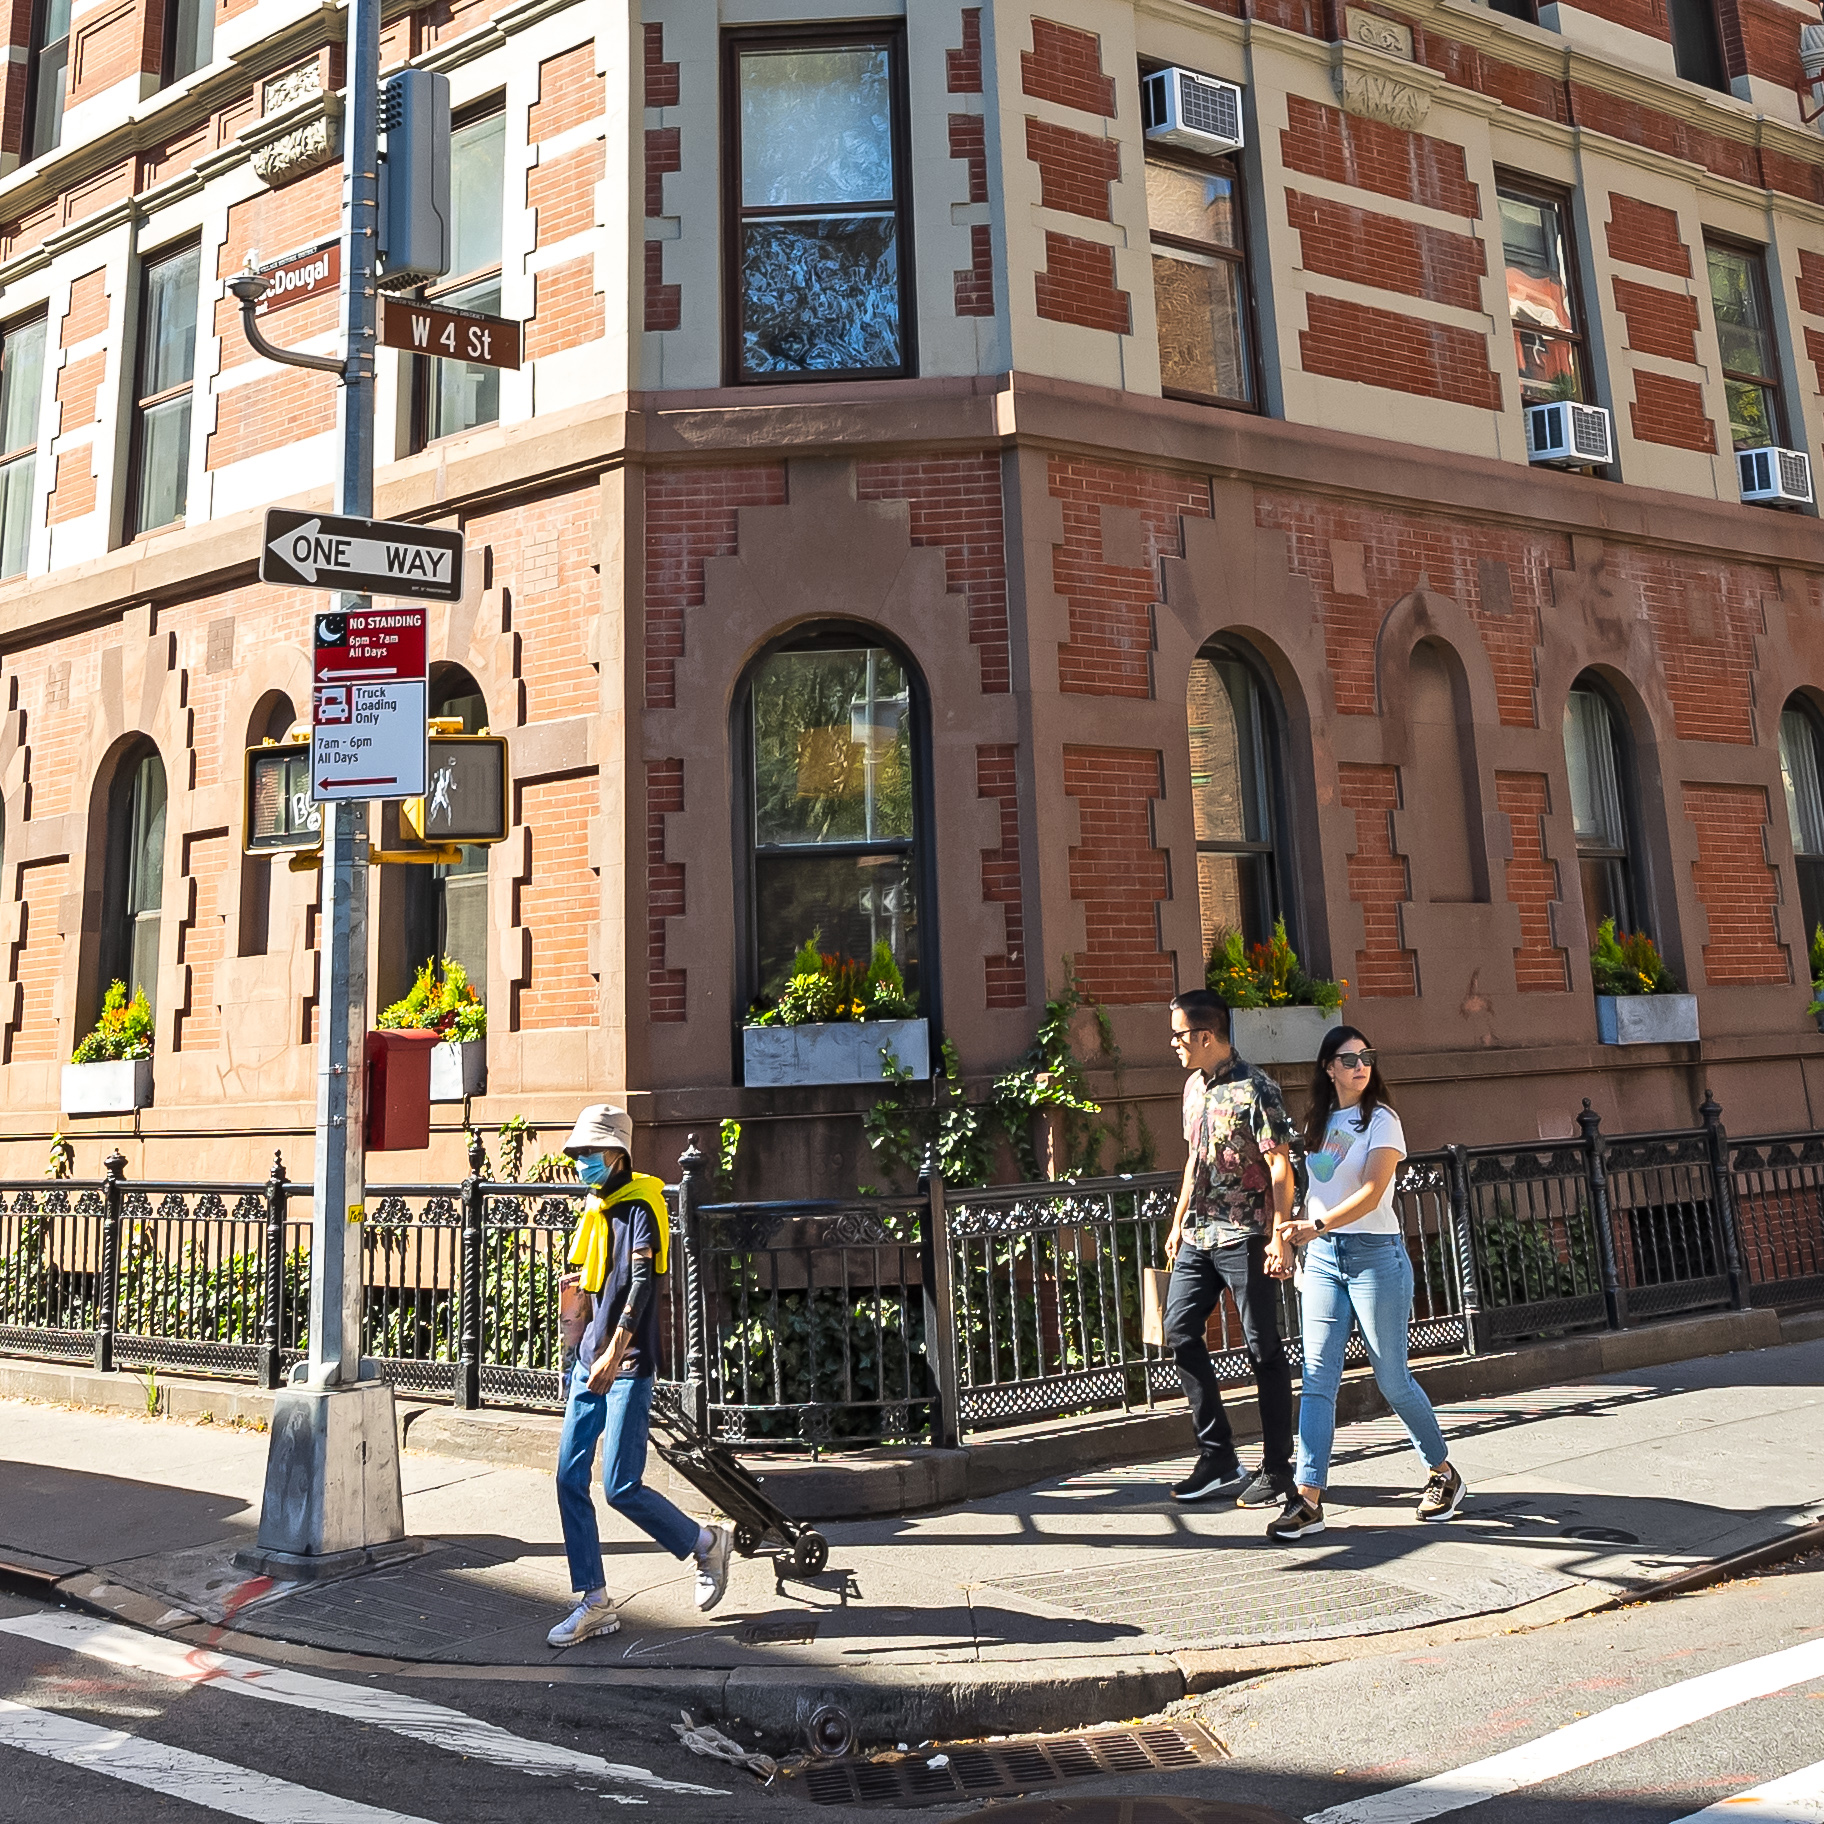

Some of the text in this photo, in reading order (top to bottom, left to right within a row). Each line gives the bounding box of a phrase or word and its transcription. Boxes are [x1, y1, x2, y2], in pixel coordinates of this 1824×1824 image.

[408, 299, 432, 310] VILLAGE
[432, 305, 459, 315] HISTORIC
[459, 311, 485, 320] DISTRICT
[412, 315, 491, 359] W 4 St
[292, 534, 446, 577] ONE WAY
[349, 615, 422, 630] NO STANDING
[349, 635, 370, 647] 6pm
[378, 634, 399, 644] 7am
[349, 647, 387, 658] All Days
[356, 686, 386, 698] Truck
[356, 699, 397, 712] Loading
[356, 712, 379, 725] Only
[318, 738, 339, 749] 7am
[350, 736, 372, 749] 6pm
[318, 751, 359, 765] All Days
